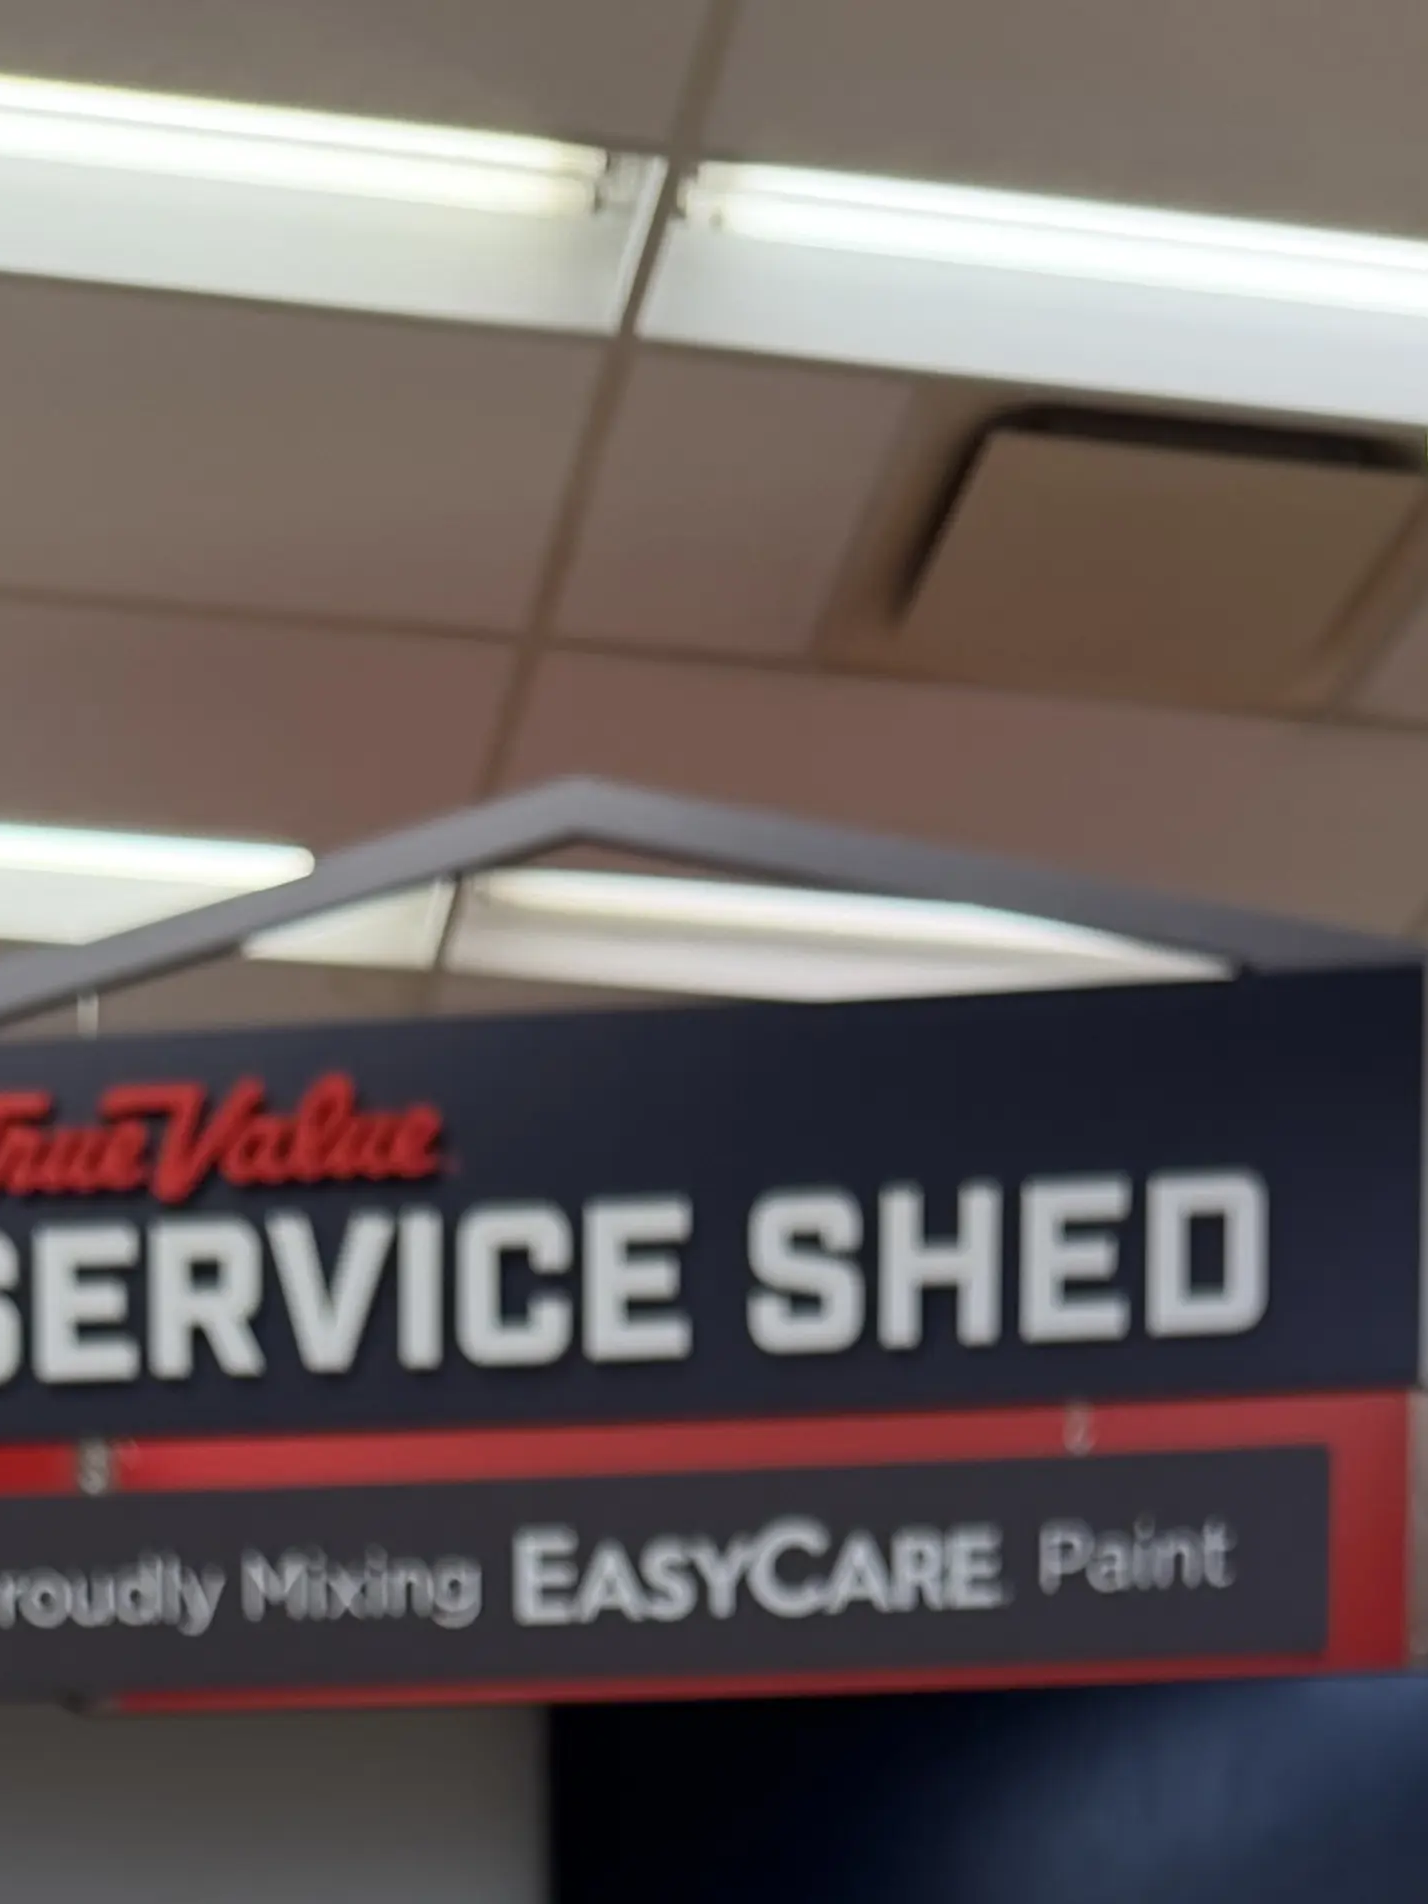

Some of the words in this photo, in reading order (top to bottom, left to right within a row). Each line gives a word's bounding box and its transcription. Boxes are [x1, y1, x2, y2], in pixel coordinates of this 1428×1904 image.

[746, 1169, 1269, 1356] SHED
[240, 1544, 482, 1630] Mixing
[1038, 1510, 1236, 1595] Paint
